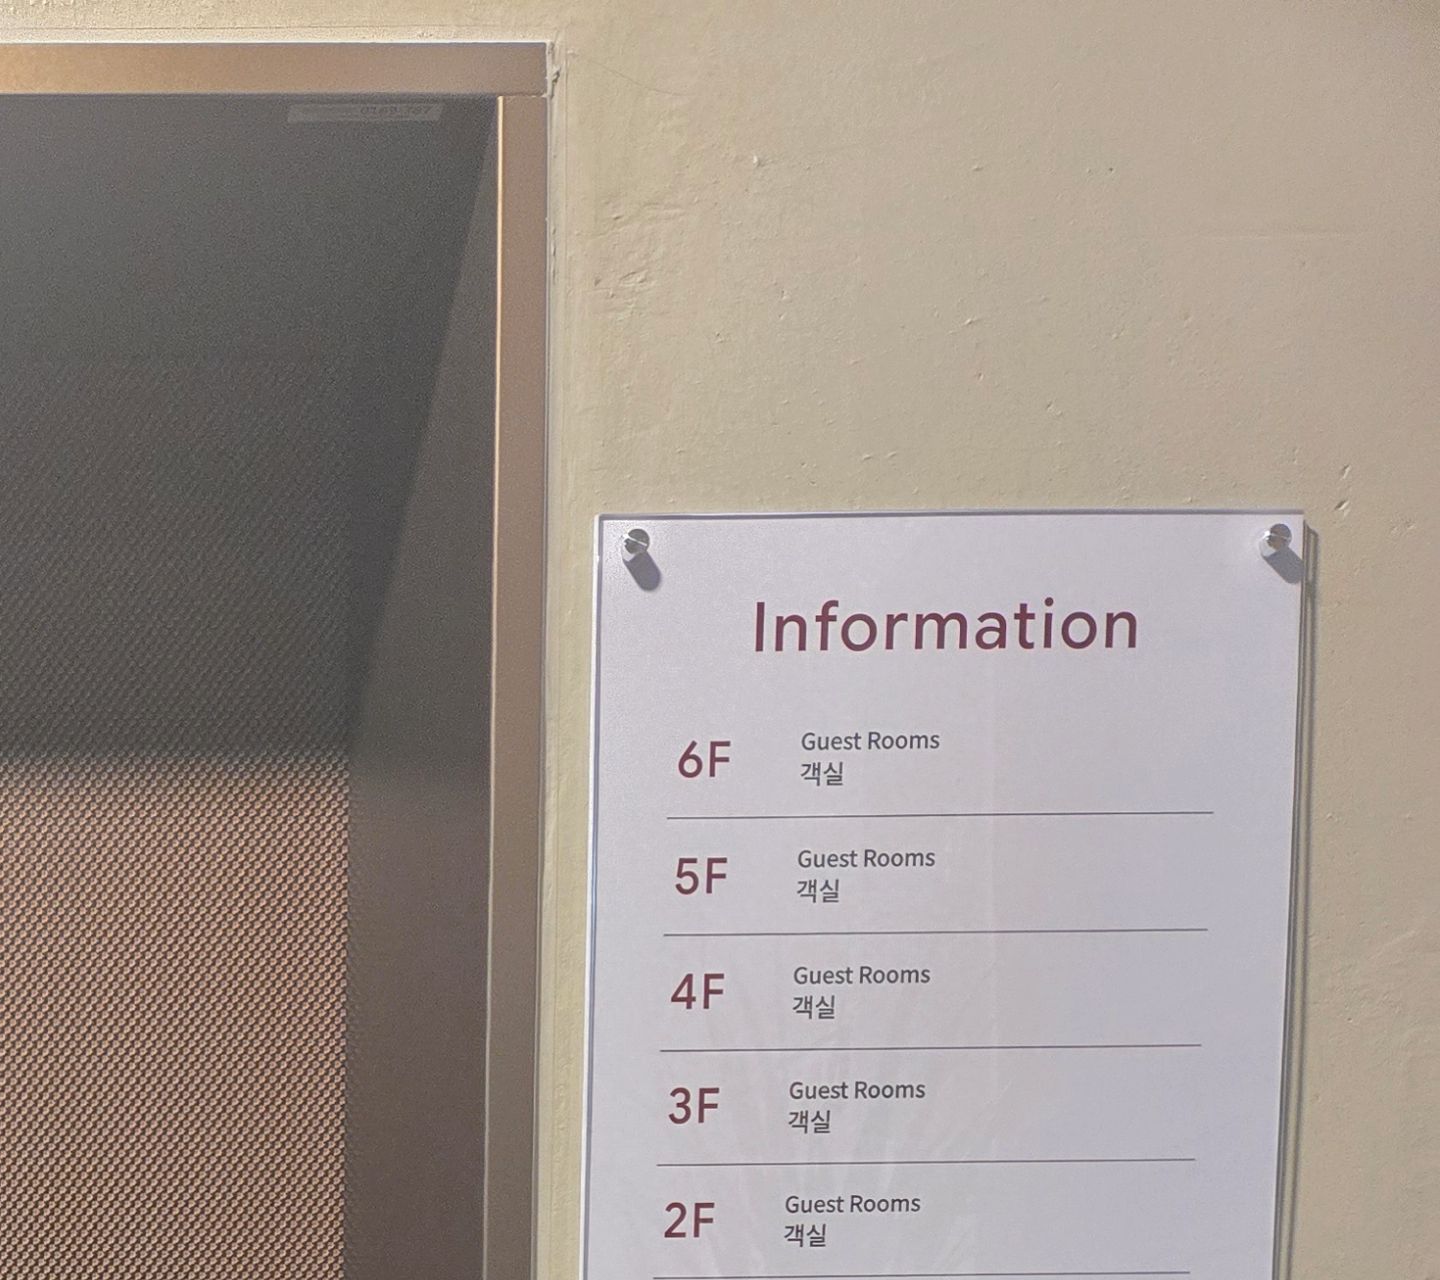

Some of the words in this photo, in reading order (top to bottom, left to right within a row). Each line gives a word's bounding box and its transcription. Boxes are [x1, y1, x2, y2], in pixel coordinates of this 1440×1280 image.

[754, 596, 1138, 653] Information
[801, 731, 862, 751] Guest
[867, 731, 940, 751] Rooms
[677, 740, 732, 779] 6F
[800, 761, 844, 787] 객실
[797, 849, 858, 869] Guest
[863, 848, 936, 868] Rooms
[674, 856, 728, 896] 5F
[796, 878, 840, 904] 객실
[793, 966, 854, 985] Guest
[859, 965, 931, 985] Rooms
[670, 972, 725, 1010] 4F
[792, 994, 836, 1020] 객실
[789, 1081, 849, 1100] Guest
[854, 1080, 926, 1100] Rooms
[668, 1087, 720, 1125] 3F
[787, 1109, 831, 1135] 객실
[785, 1195, 845, 1214] Guest
[849, 1194, 921, 1213] Rooms
[663, 1201, 716, 1239] 2F
[783, 1223, 827, 1248] 객실
